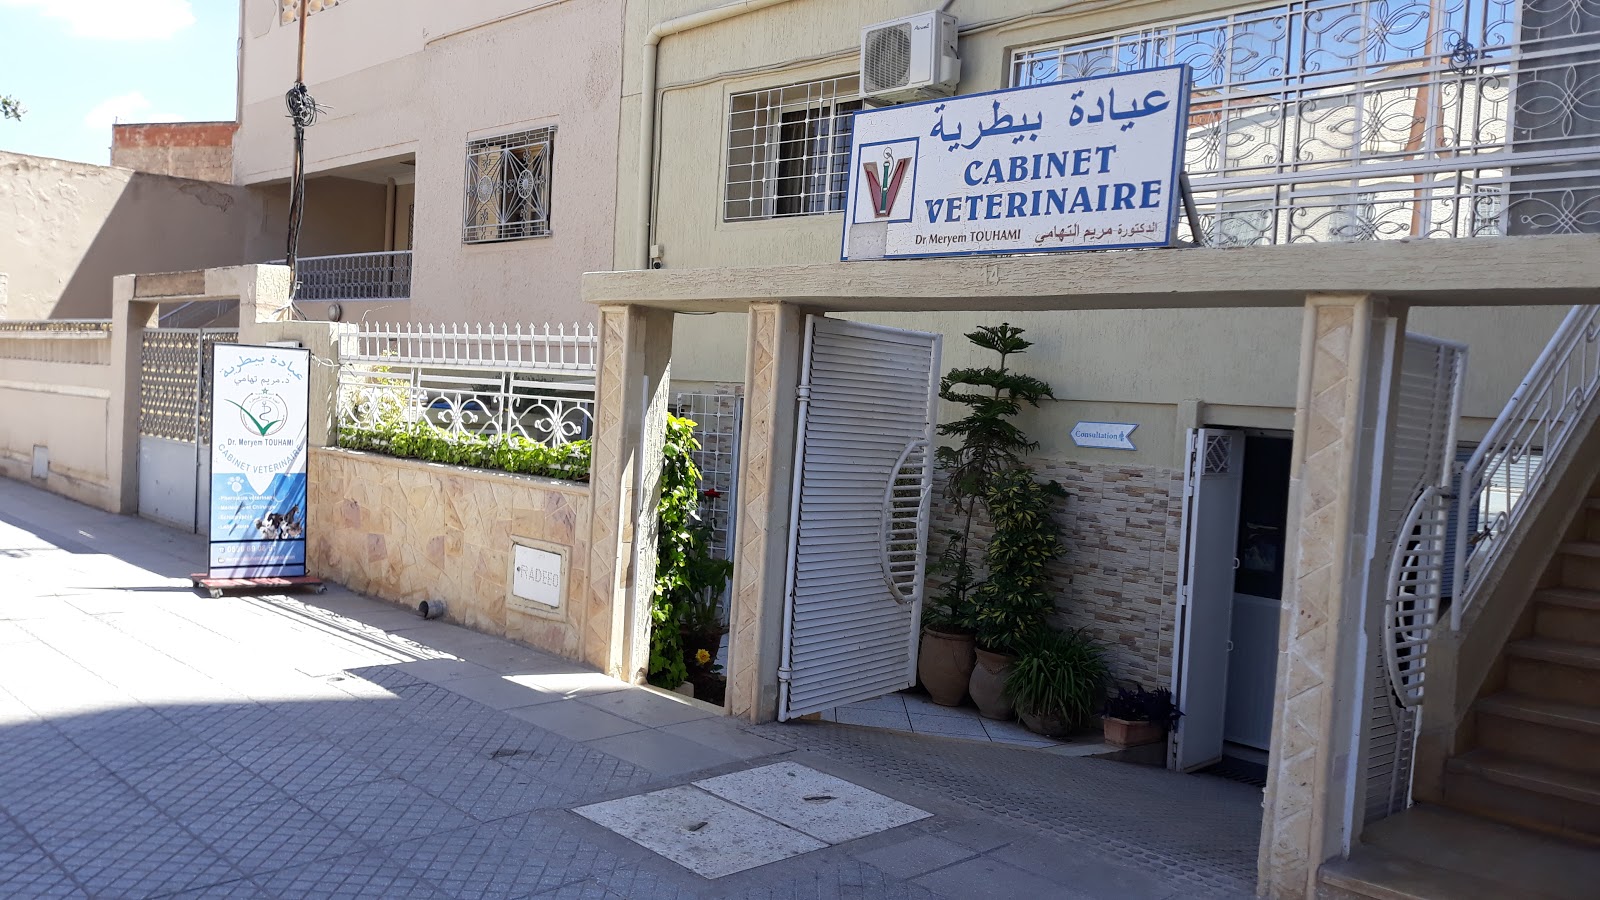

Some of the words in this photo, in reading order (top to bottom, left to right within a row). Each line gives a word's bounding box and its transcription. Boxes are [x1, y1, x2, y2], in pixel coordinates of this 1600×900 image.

[1069, 88, 1171, 132] عيادة
[930, 100, 1043, 152] بيطرية
[964, 145, 1117, 186] CABINET
[924, 180, 1162, 224] VETERINAIRE
[915, 234, 927, 245] Dr
[928, 231, 967, 247] Meryem
[970, 229, 1021, 242] TOUHAMI
[1035, 224, 1080, 246] التهامي
[1083, 226, 1113, 243] مريم
[1117, 222, 1158, 238] الدكتورة
[219, 355, 265, 378] بيطرية
[270, 354, 303, 380] عيادة
[227, 438, 237, 446] Dr.
[239, 438, 263, 448] Meryem
[265, 438, 294, 446] TOUHAMI
[1075, 430, 1118, 440] Consultation
[218, 443, 251, 473] CABINET
